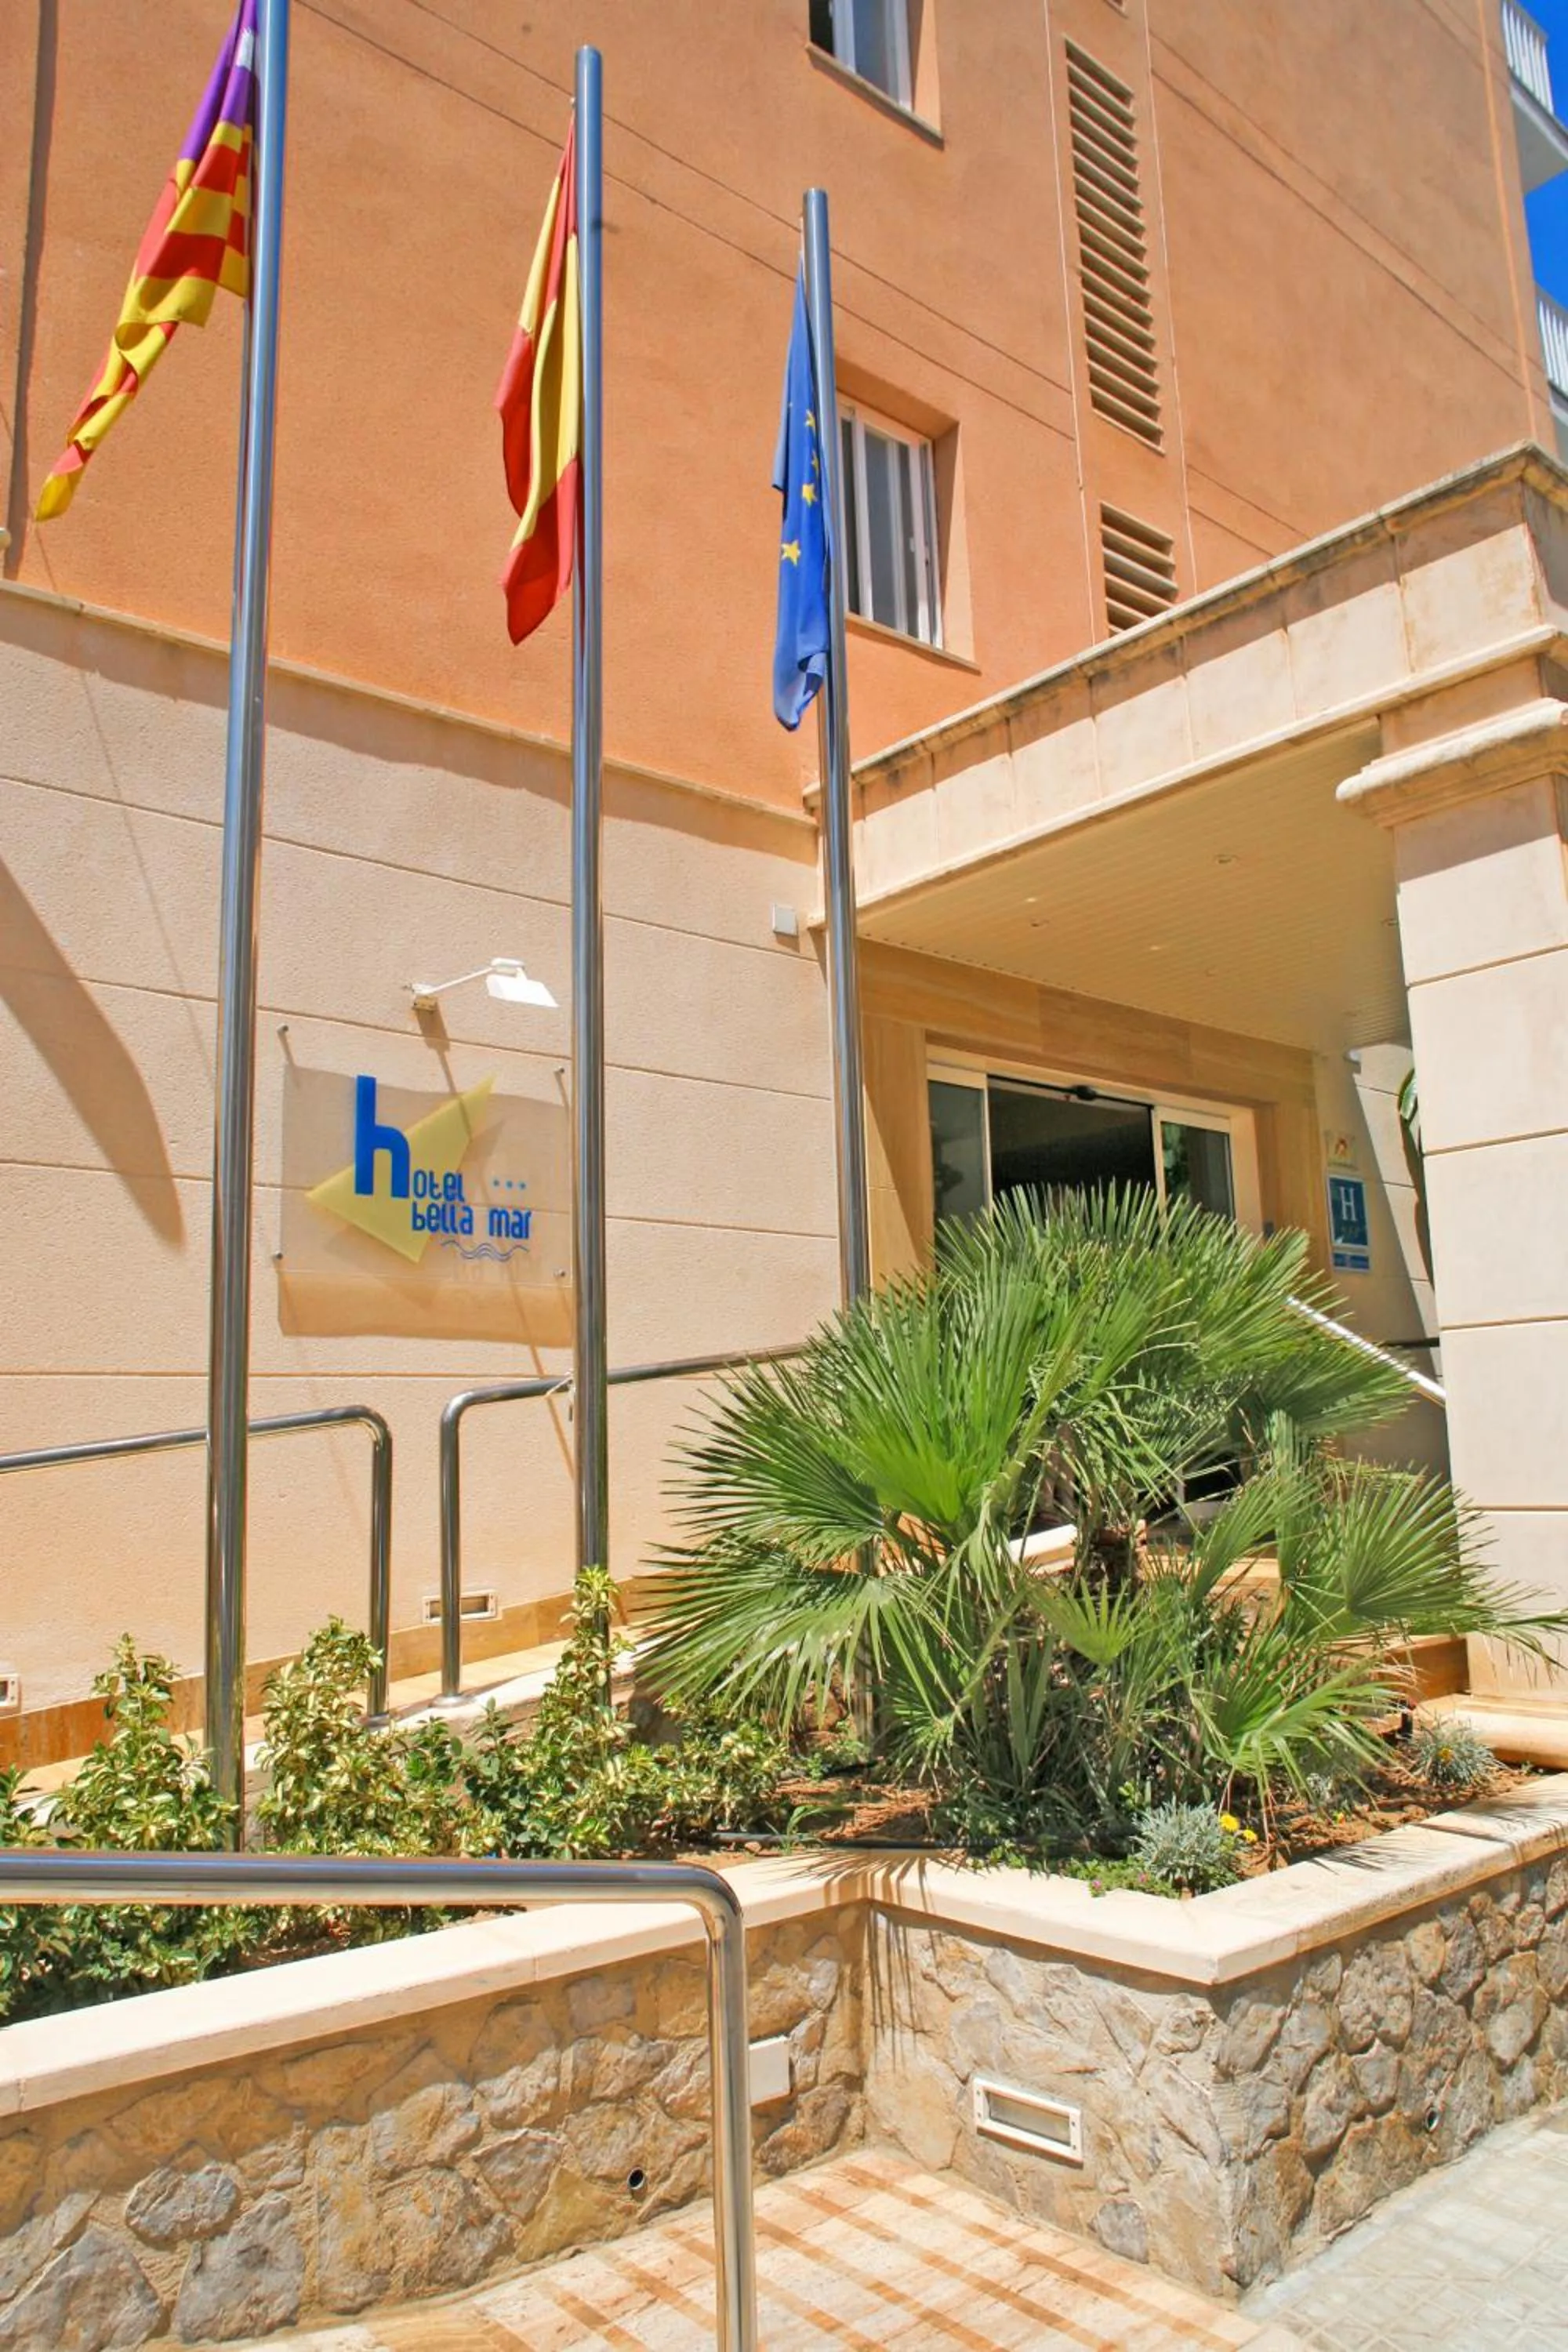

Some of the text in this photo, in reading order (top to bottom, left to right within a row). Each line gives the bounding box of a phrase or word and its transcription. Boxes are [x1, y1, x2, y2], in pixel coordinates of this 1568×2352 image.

[355, 1074, 465, 1202] hotel
[412, 1201, 532, 1240] bella mar
[1340, 1185, 1357, 1221] H
